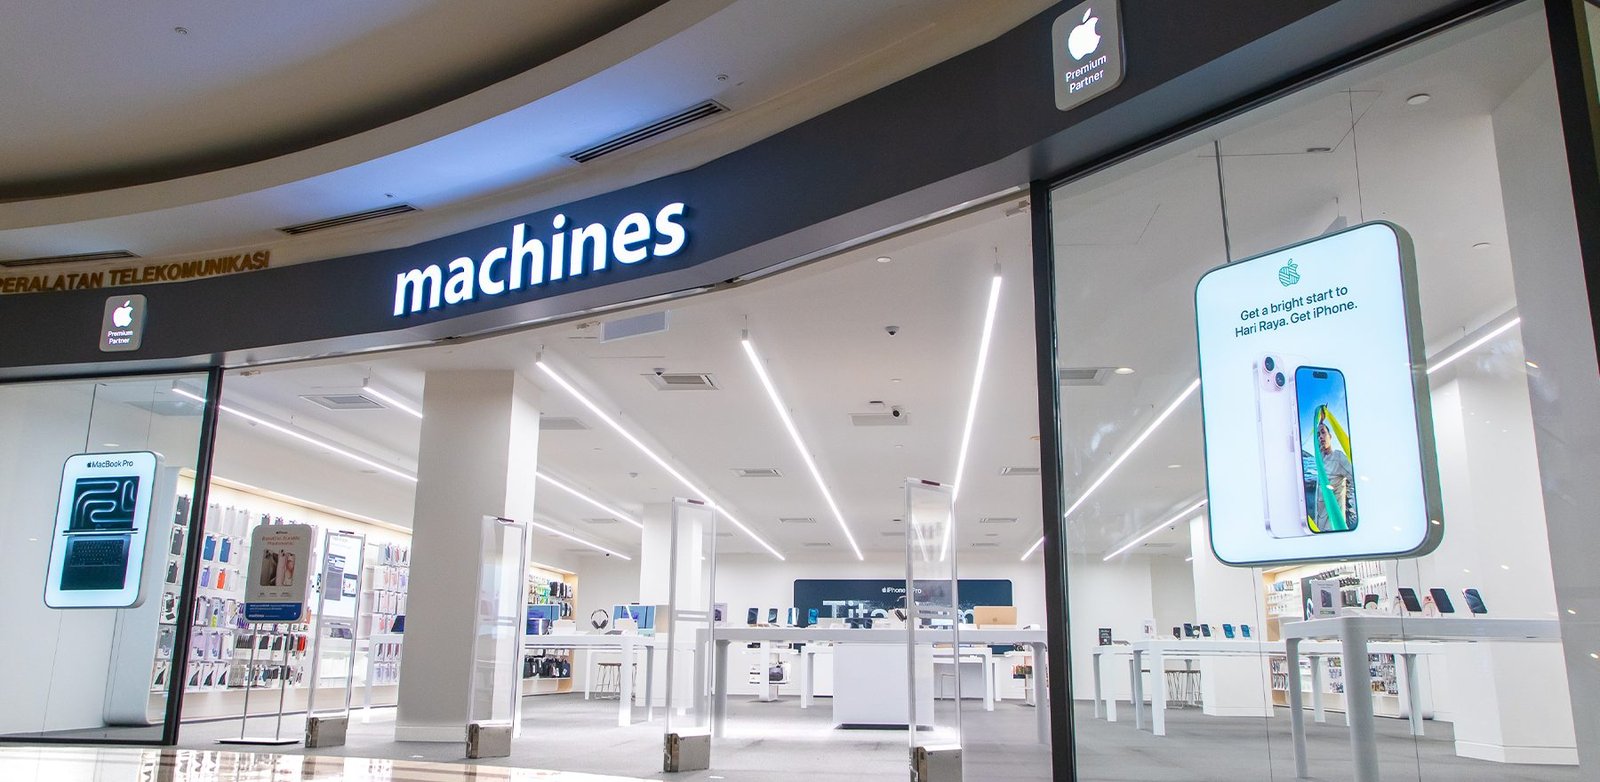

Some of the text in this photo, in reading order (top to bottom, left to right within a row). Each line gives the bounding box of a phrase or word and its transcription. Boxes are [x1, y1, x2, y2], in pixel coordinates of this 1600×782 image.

[1065, 55, 1107, 82] Premium
[1069, 69, 1104, 93] Partner
[109, 251, 270, 286] TELEKOMUNIKASI
[393, 202, 687, 317] machines
[1235, 300, 1358, 337] Hari Raya. Get iPhone.
[1240, 285, 1348, 321] Get a bright start to
[108, 337, 130, 345] Partner
[92, 459, 133, 468] MacBook Pro
